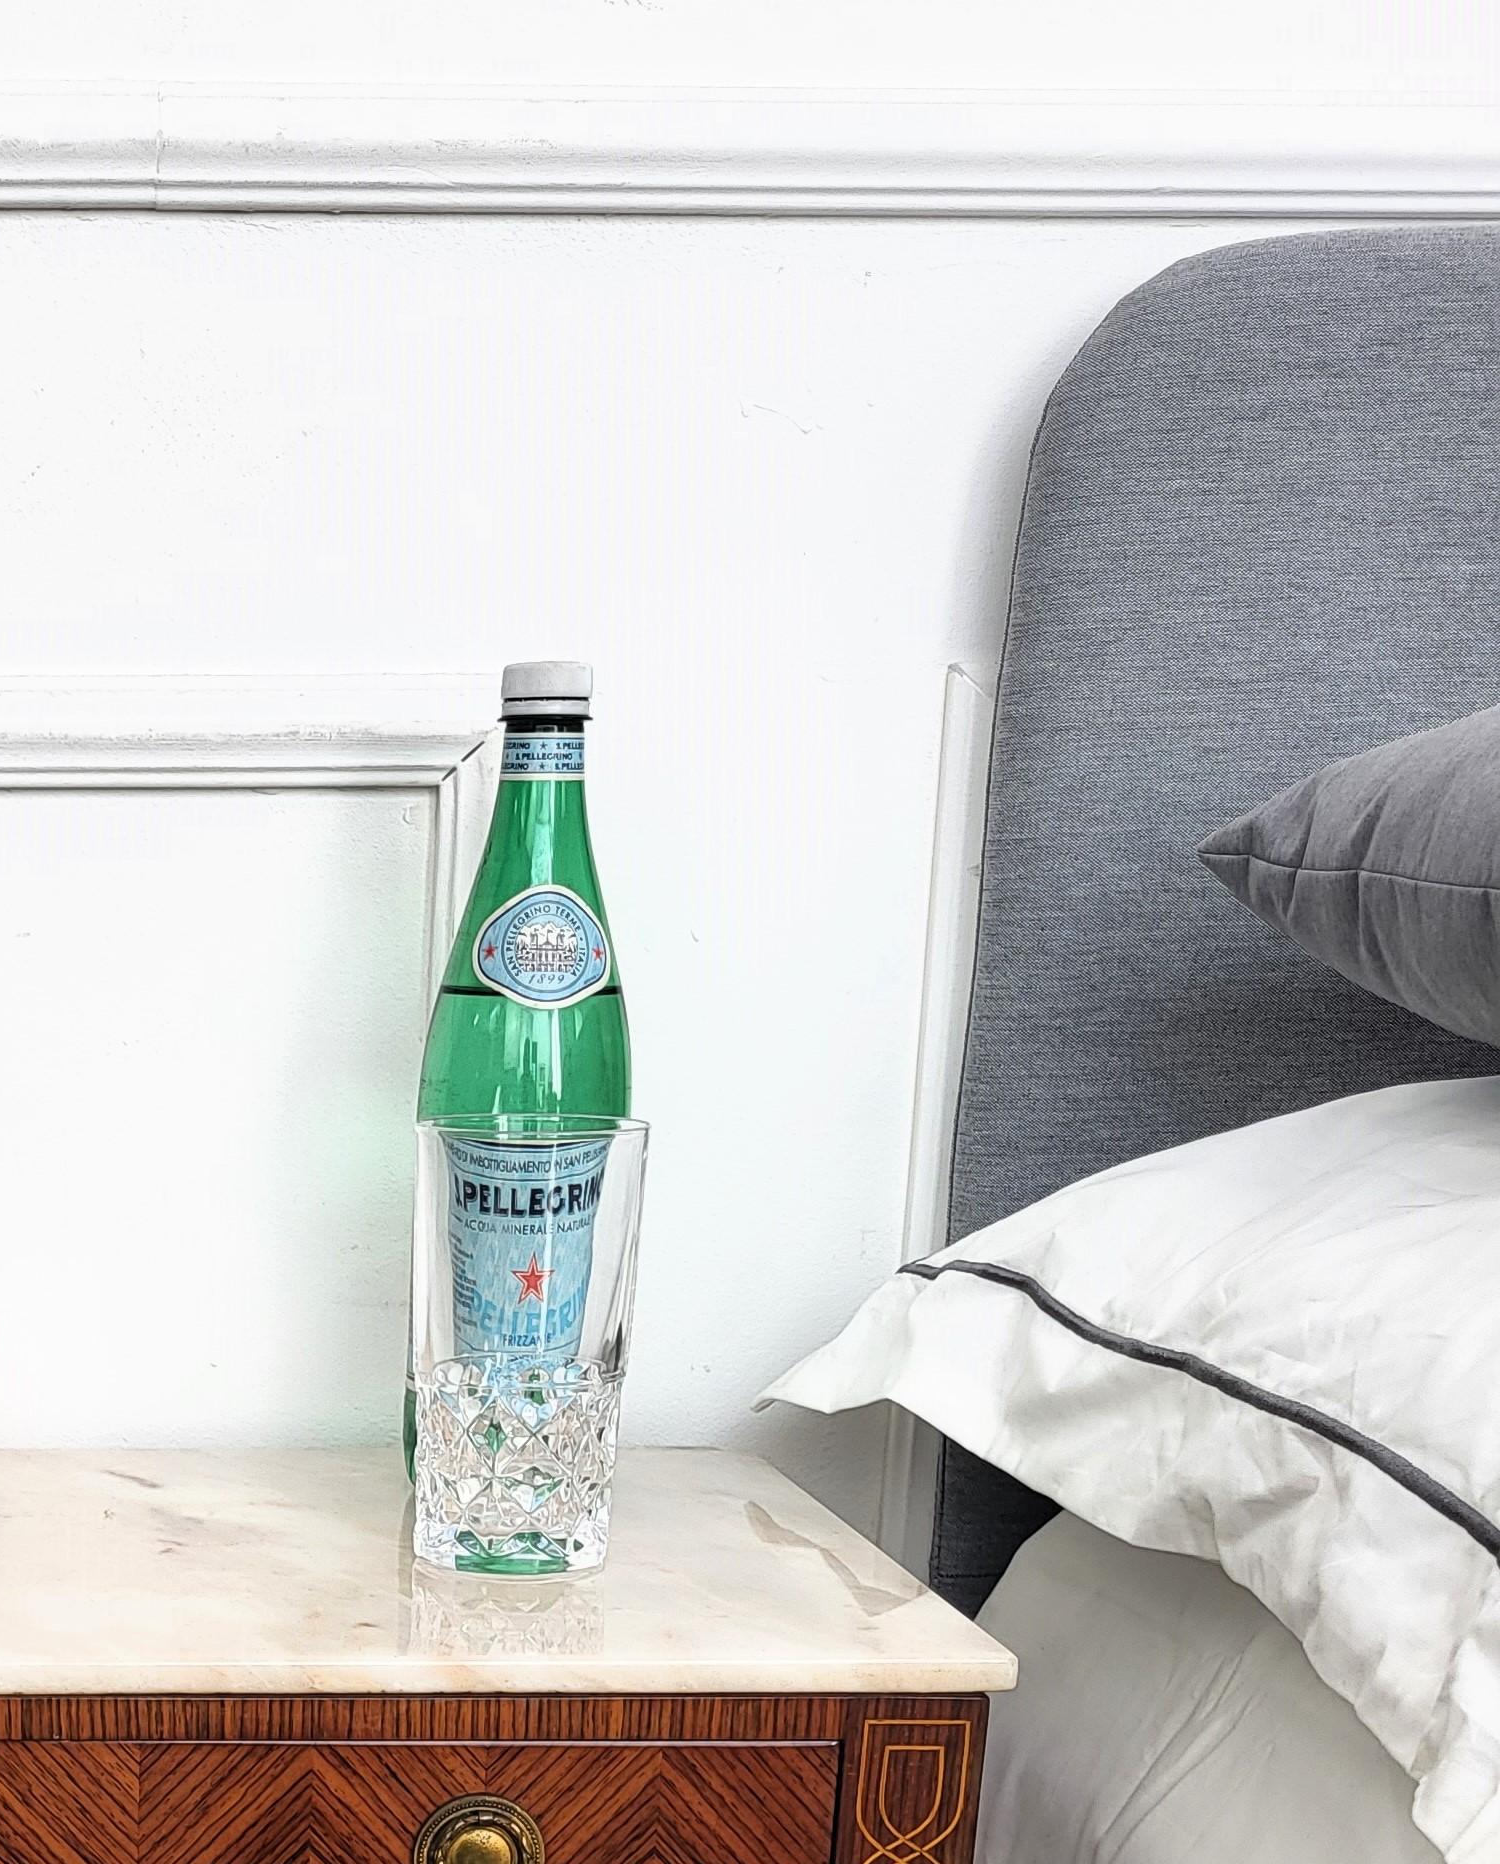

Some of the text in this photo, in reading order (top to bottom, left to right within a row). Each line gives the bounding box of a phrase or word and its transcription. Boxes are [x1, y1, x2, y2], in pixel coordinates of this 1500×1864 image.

[506, 904, 587, 977] SAN PELLEGRINO TERME ITALIA
[528, 973, 565, 985] 1899
[563, 1153, 581, 1170] SAN
[464, 1219, 497, 1234] ACQUA
